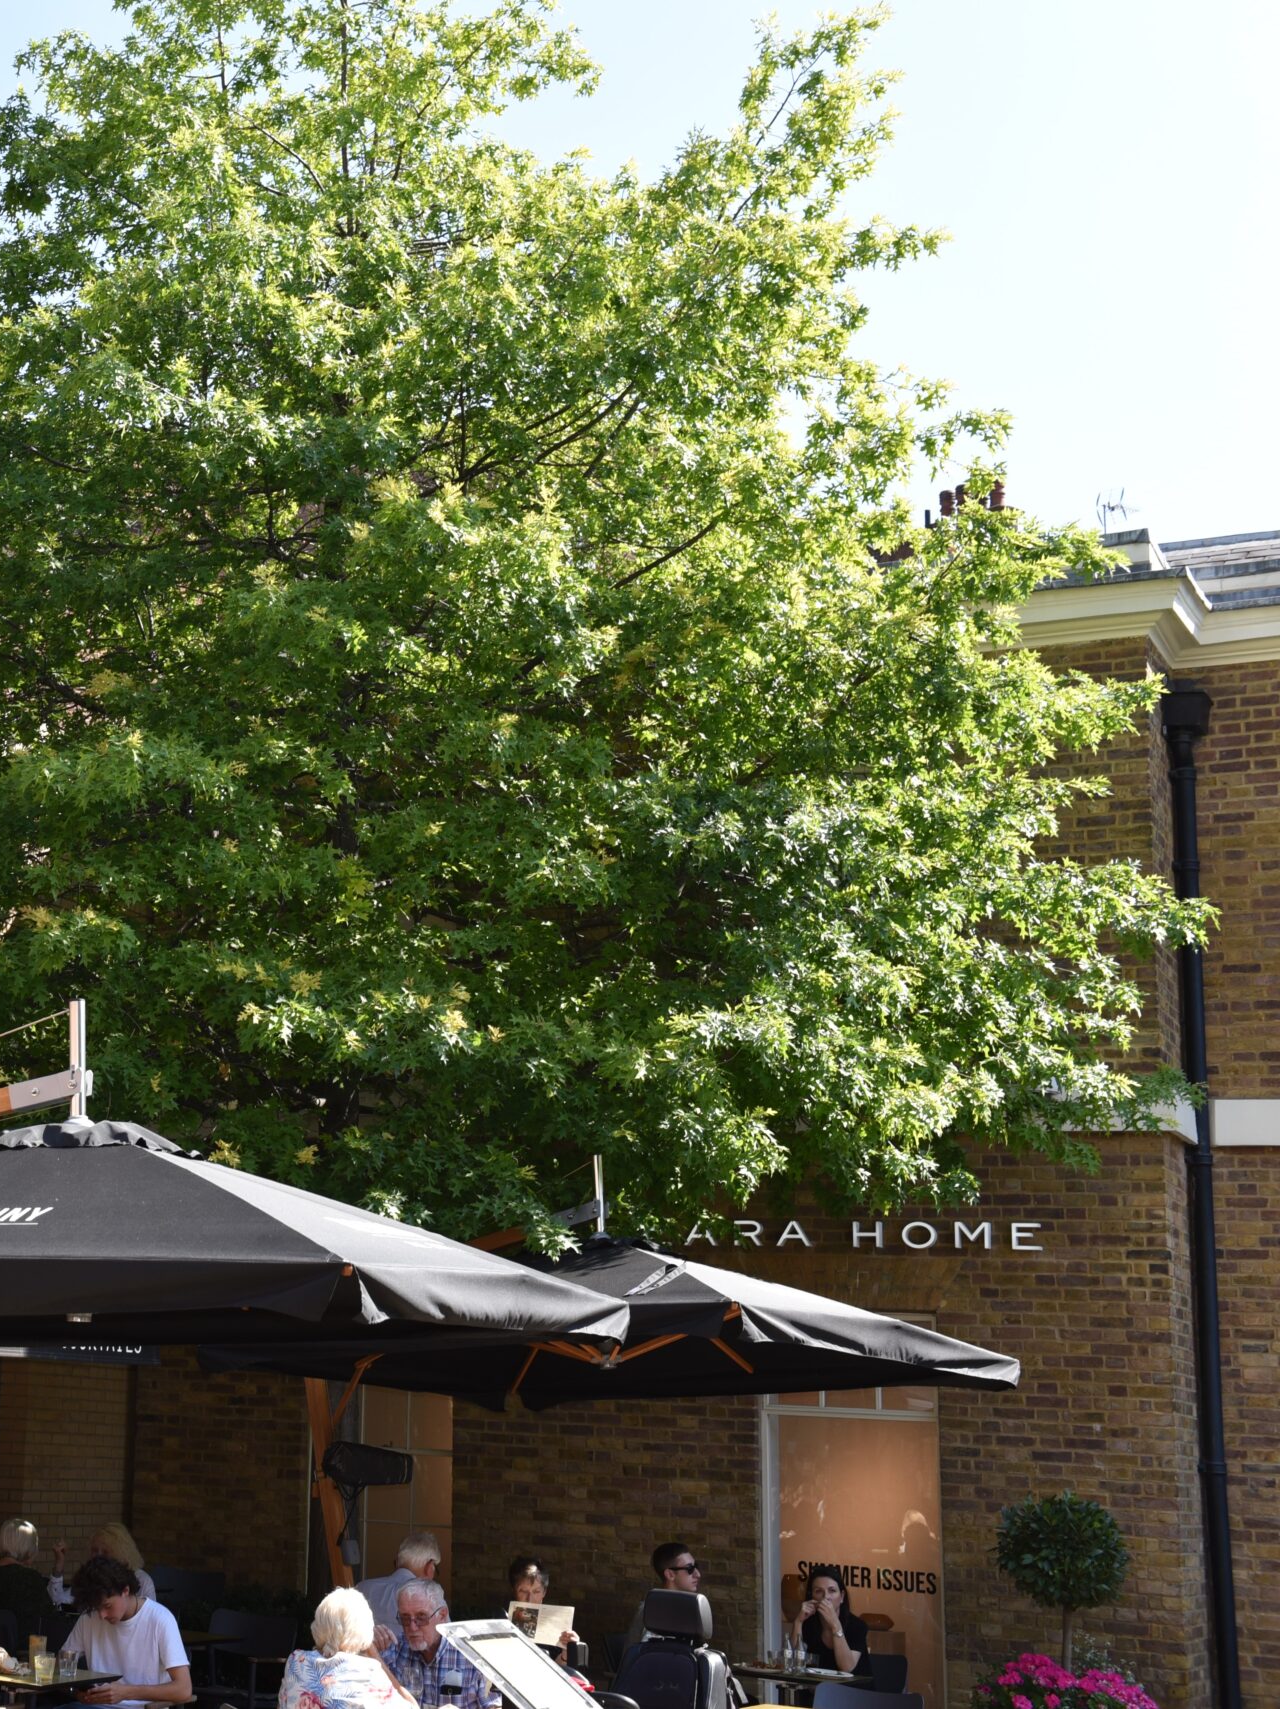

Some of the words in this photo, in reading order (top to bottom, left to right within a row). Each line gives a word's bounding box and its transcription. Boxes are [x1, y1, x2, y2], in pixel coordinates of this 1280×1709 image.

[684, 1220, 812, 1247] ARA
[852, 1220, 1044, 1252] HOME
[876, 1567, 937, 1595] ISSUES
